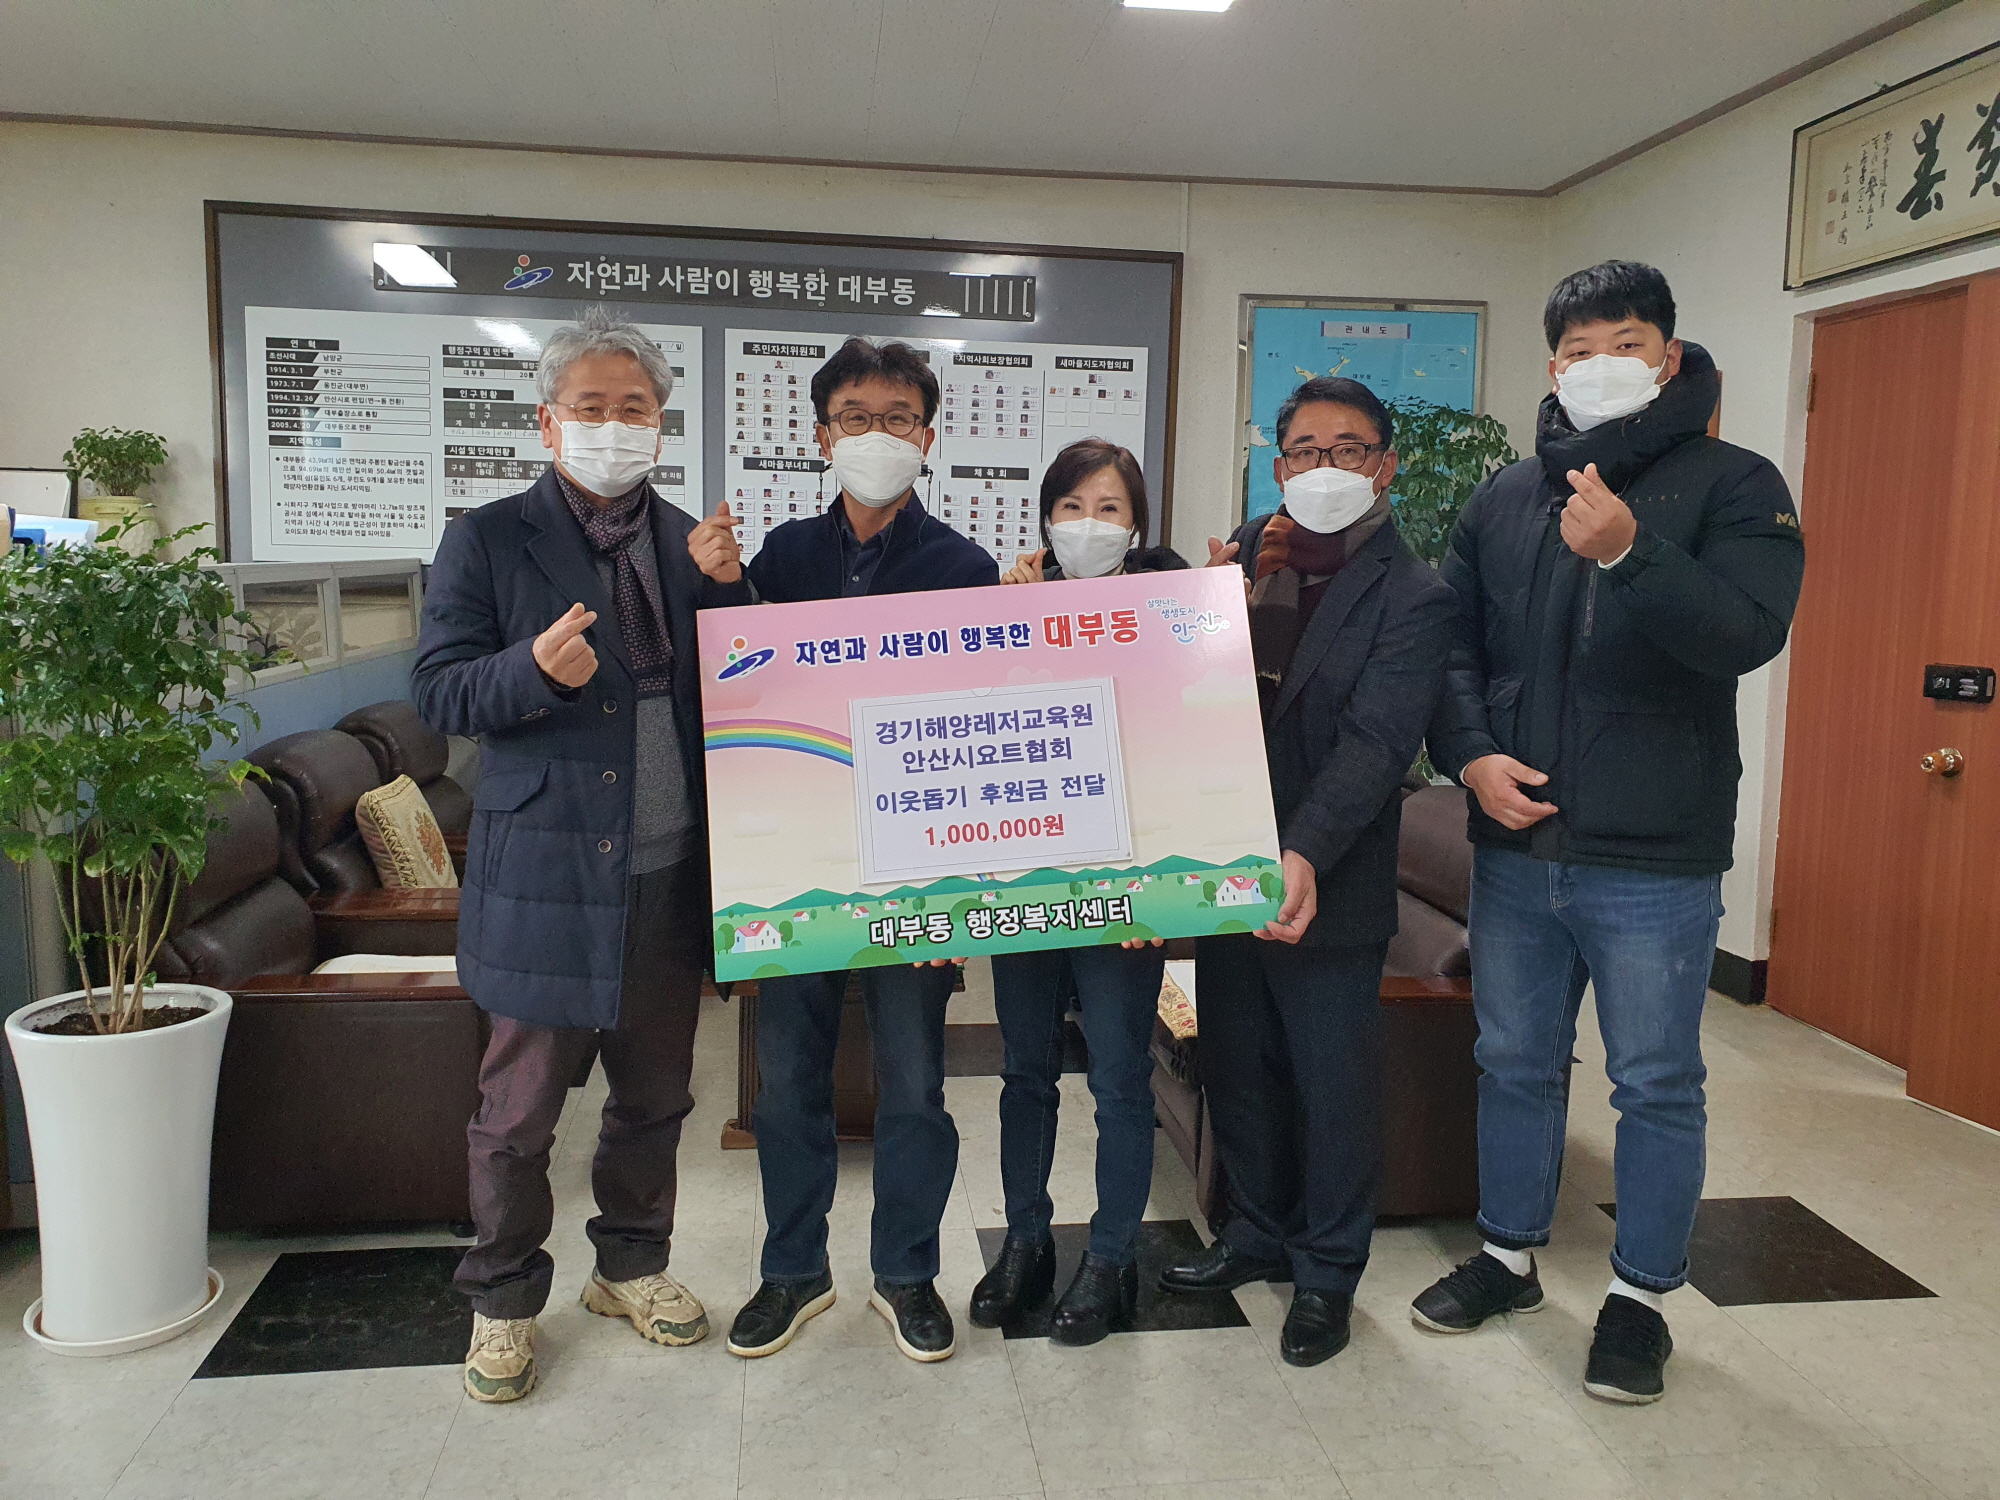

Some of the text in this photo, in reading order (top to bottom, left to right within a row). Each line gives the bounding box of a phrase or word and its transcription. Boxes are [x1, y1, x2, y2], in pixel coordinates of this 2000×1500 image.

[567, 261, 916, 305] 자연과 사람이 행복한 대부동
[448, 346, 480, 356] 행정구역
[483, 347, 491, 356] 및
[752, 344, 817, 357] 주민자치위원회
[1060, 358, 1129, 370] 새마을지도자협의회
[324, 423, 372, 432] 대부동으로 전환
[289, 437, 322, 446] 지역특성
[449, 446, 510, 457] 시설 및 단체현황
[759, 459, 810, 471] 새마을부녀회
[1147, 598, 1177, 608] 살맛나는
[1161, 606, 1196, 619] 생생도시
[796, 609, 1140, 667] 자연과 사람이 행복한 대부동
[875, 703, 1094, 745] 경기해양레저교육원
[902, 736, 1073, 775] 안산시요트협회
[876, 772, 1106, 816] 이웃돕기 후원금 전달
[925, 812, 1065, 849] 1,000,000원
[870, 896, 1133, 949] 대부동 행정복지센터
